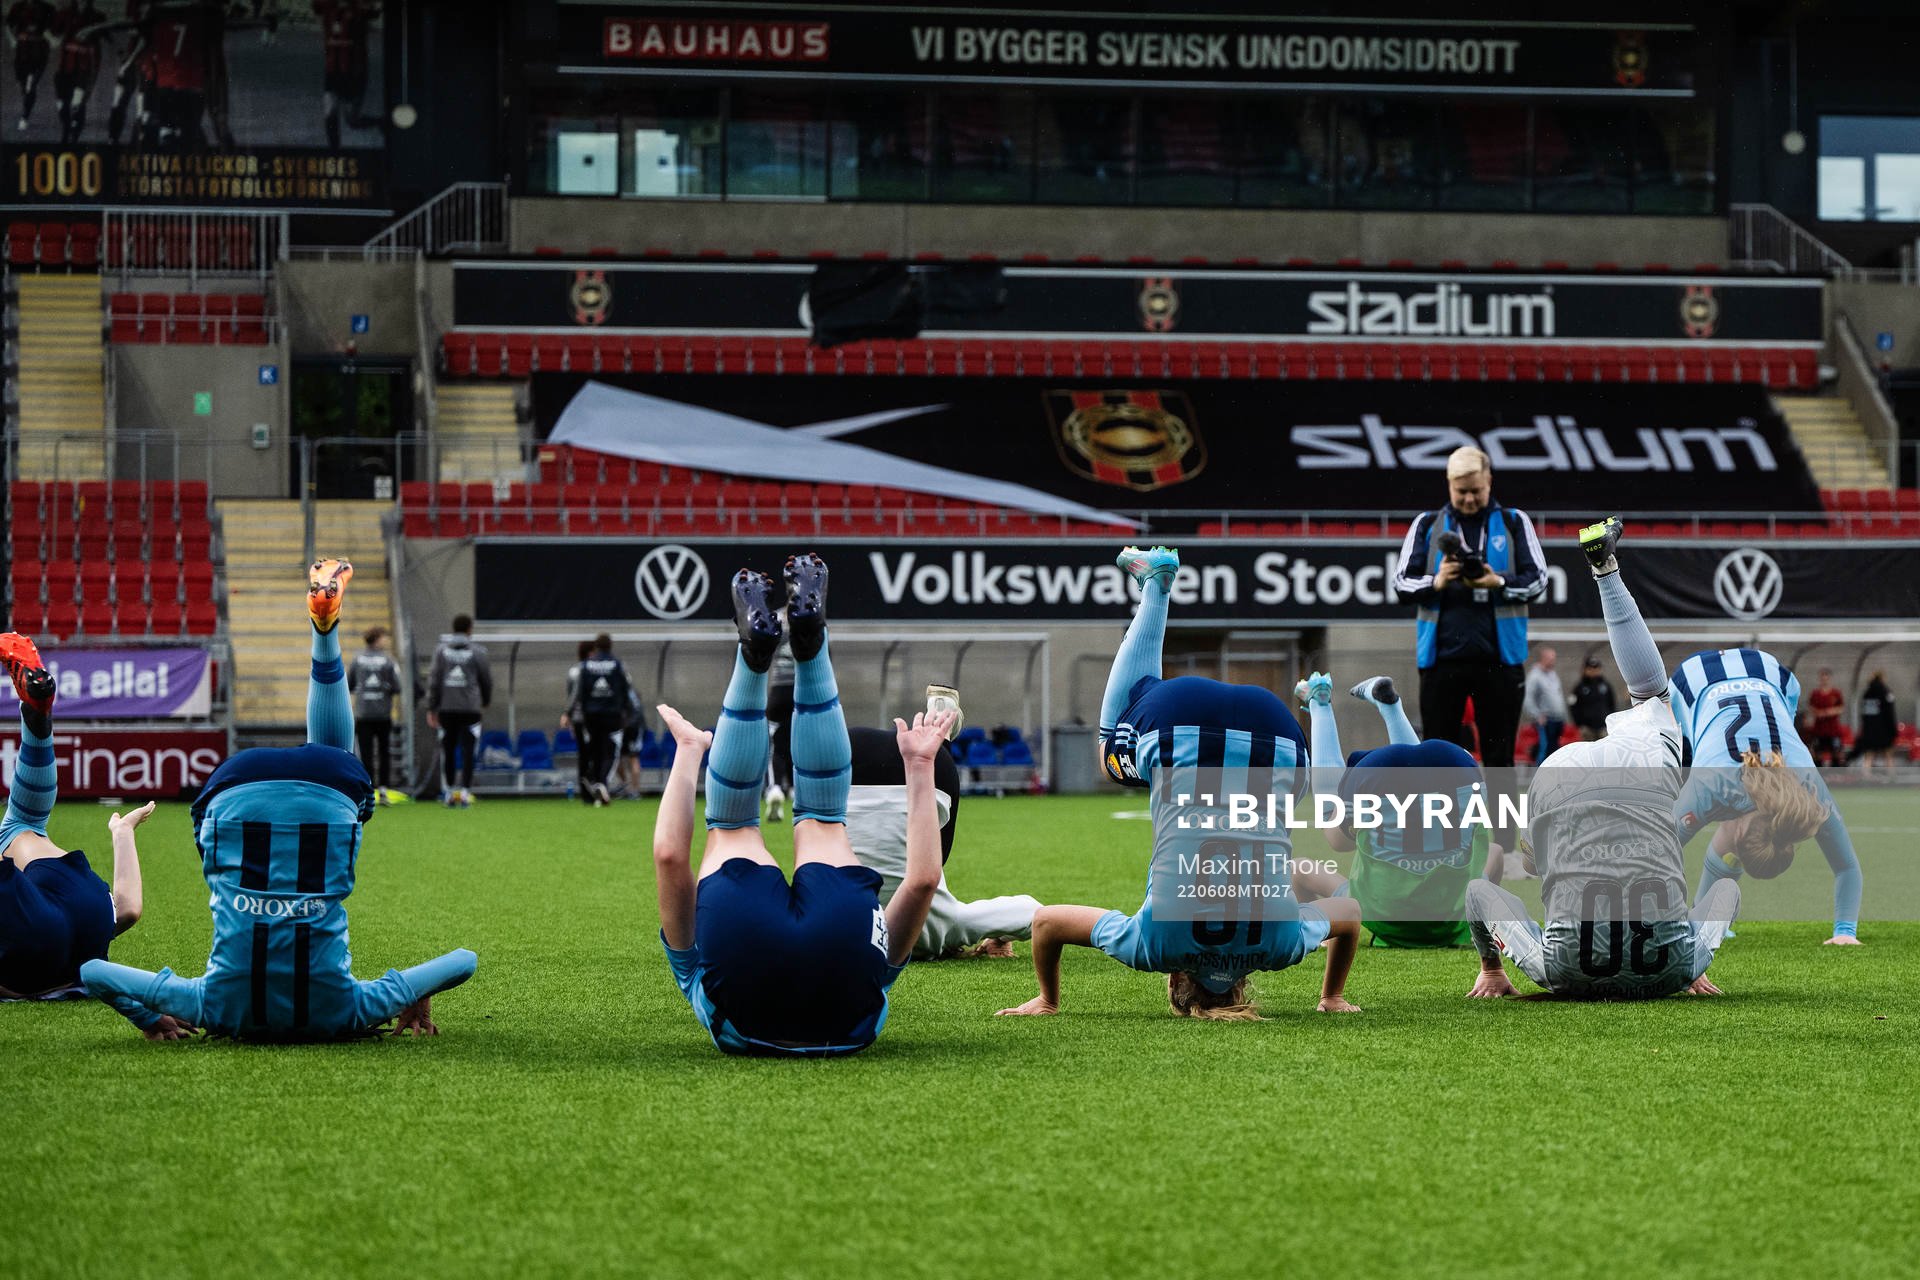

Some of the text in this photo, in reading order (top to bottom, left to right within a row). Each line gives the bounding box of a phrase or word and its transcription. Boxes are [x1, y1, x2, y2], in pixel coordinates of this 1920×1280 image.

[173, 24, 187, 57] 7
[608, 22, 829, 57] BAUHAUS
[911, 25, 1520, 75] VI BYGGER SVENSK UNGDOMSIDROTT
[15, 151, 101, 197] 1000
[1307, 280, 1556, 336] stadium
[1290, 414, 1778, 471] stadium
[89, 661, 169, 699] alla!
[1580, 879, 1669, 978] 30
